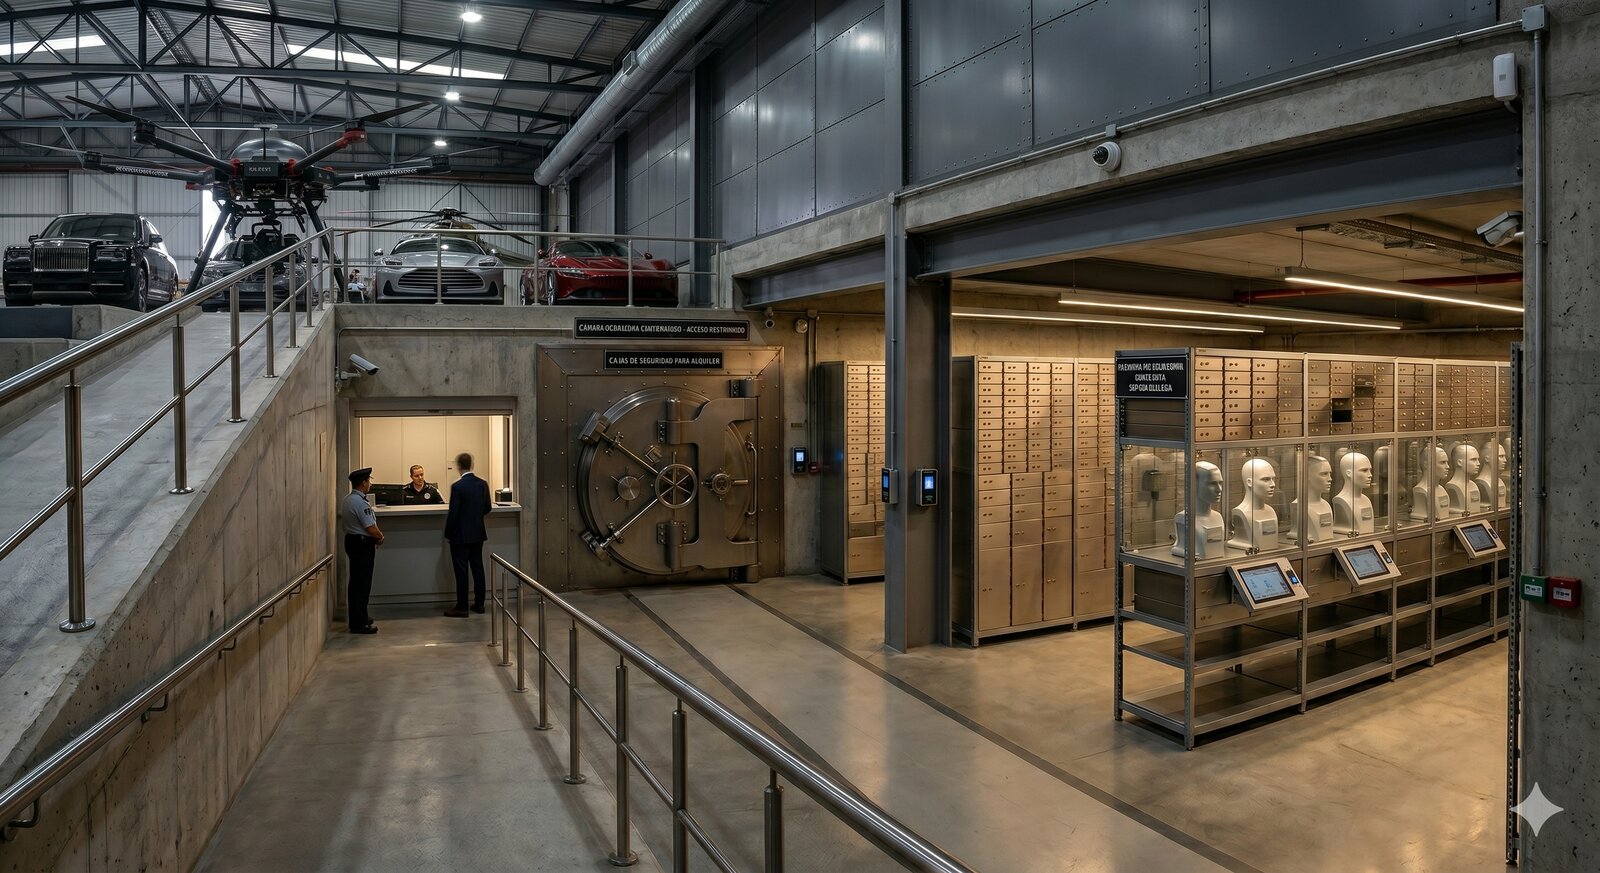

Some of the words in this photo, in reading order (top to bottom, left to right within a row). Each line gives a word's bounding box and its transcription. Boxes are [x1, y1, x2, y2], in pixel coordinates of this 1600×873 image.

[686, 325, 709, 333] ACCESO
[629, 357, 639, 365] DE
[639, 357, 674, 365] SEGURIDAD
[674, 357, 690, 365] PARA
[690, 357, 721, 365] ALQUILER
